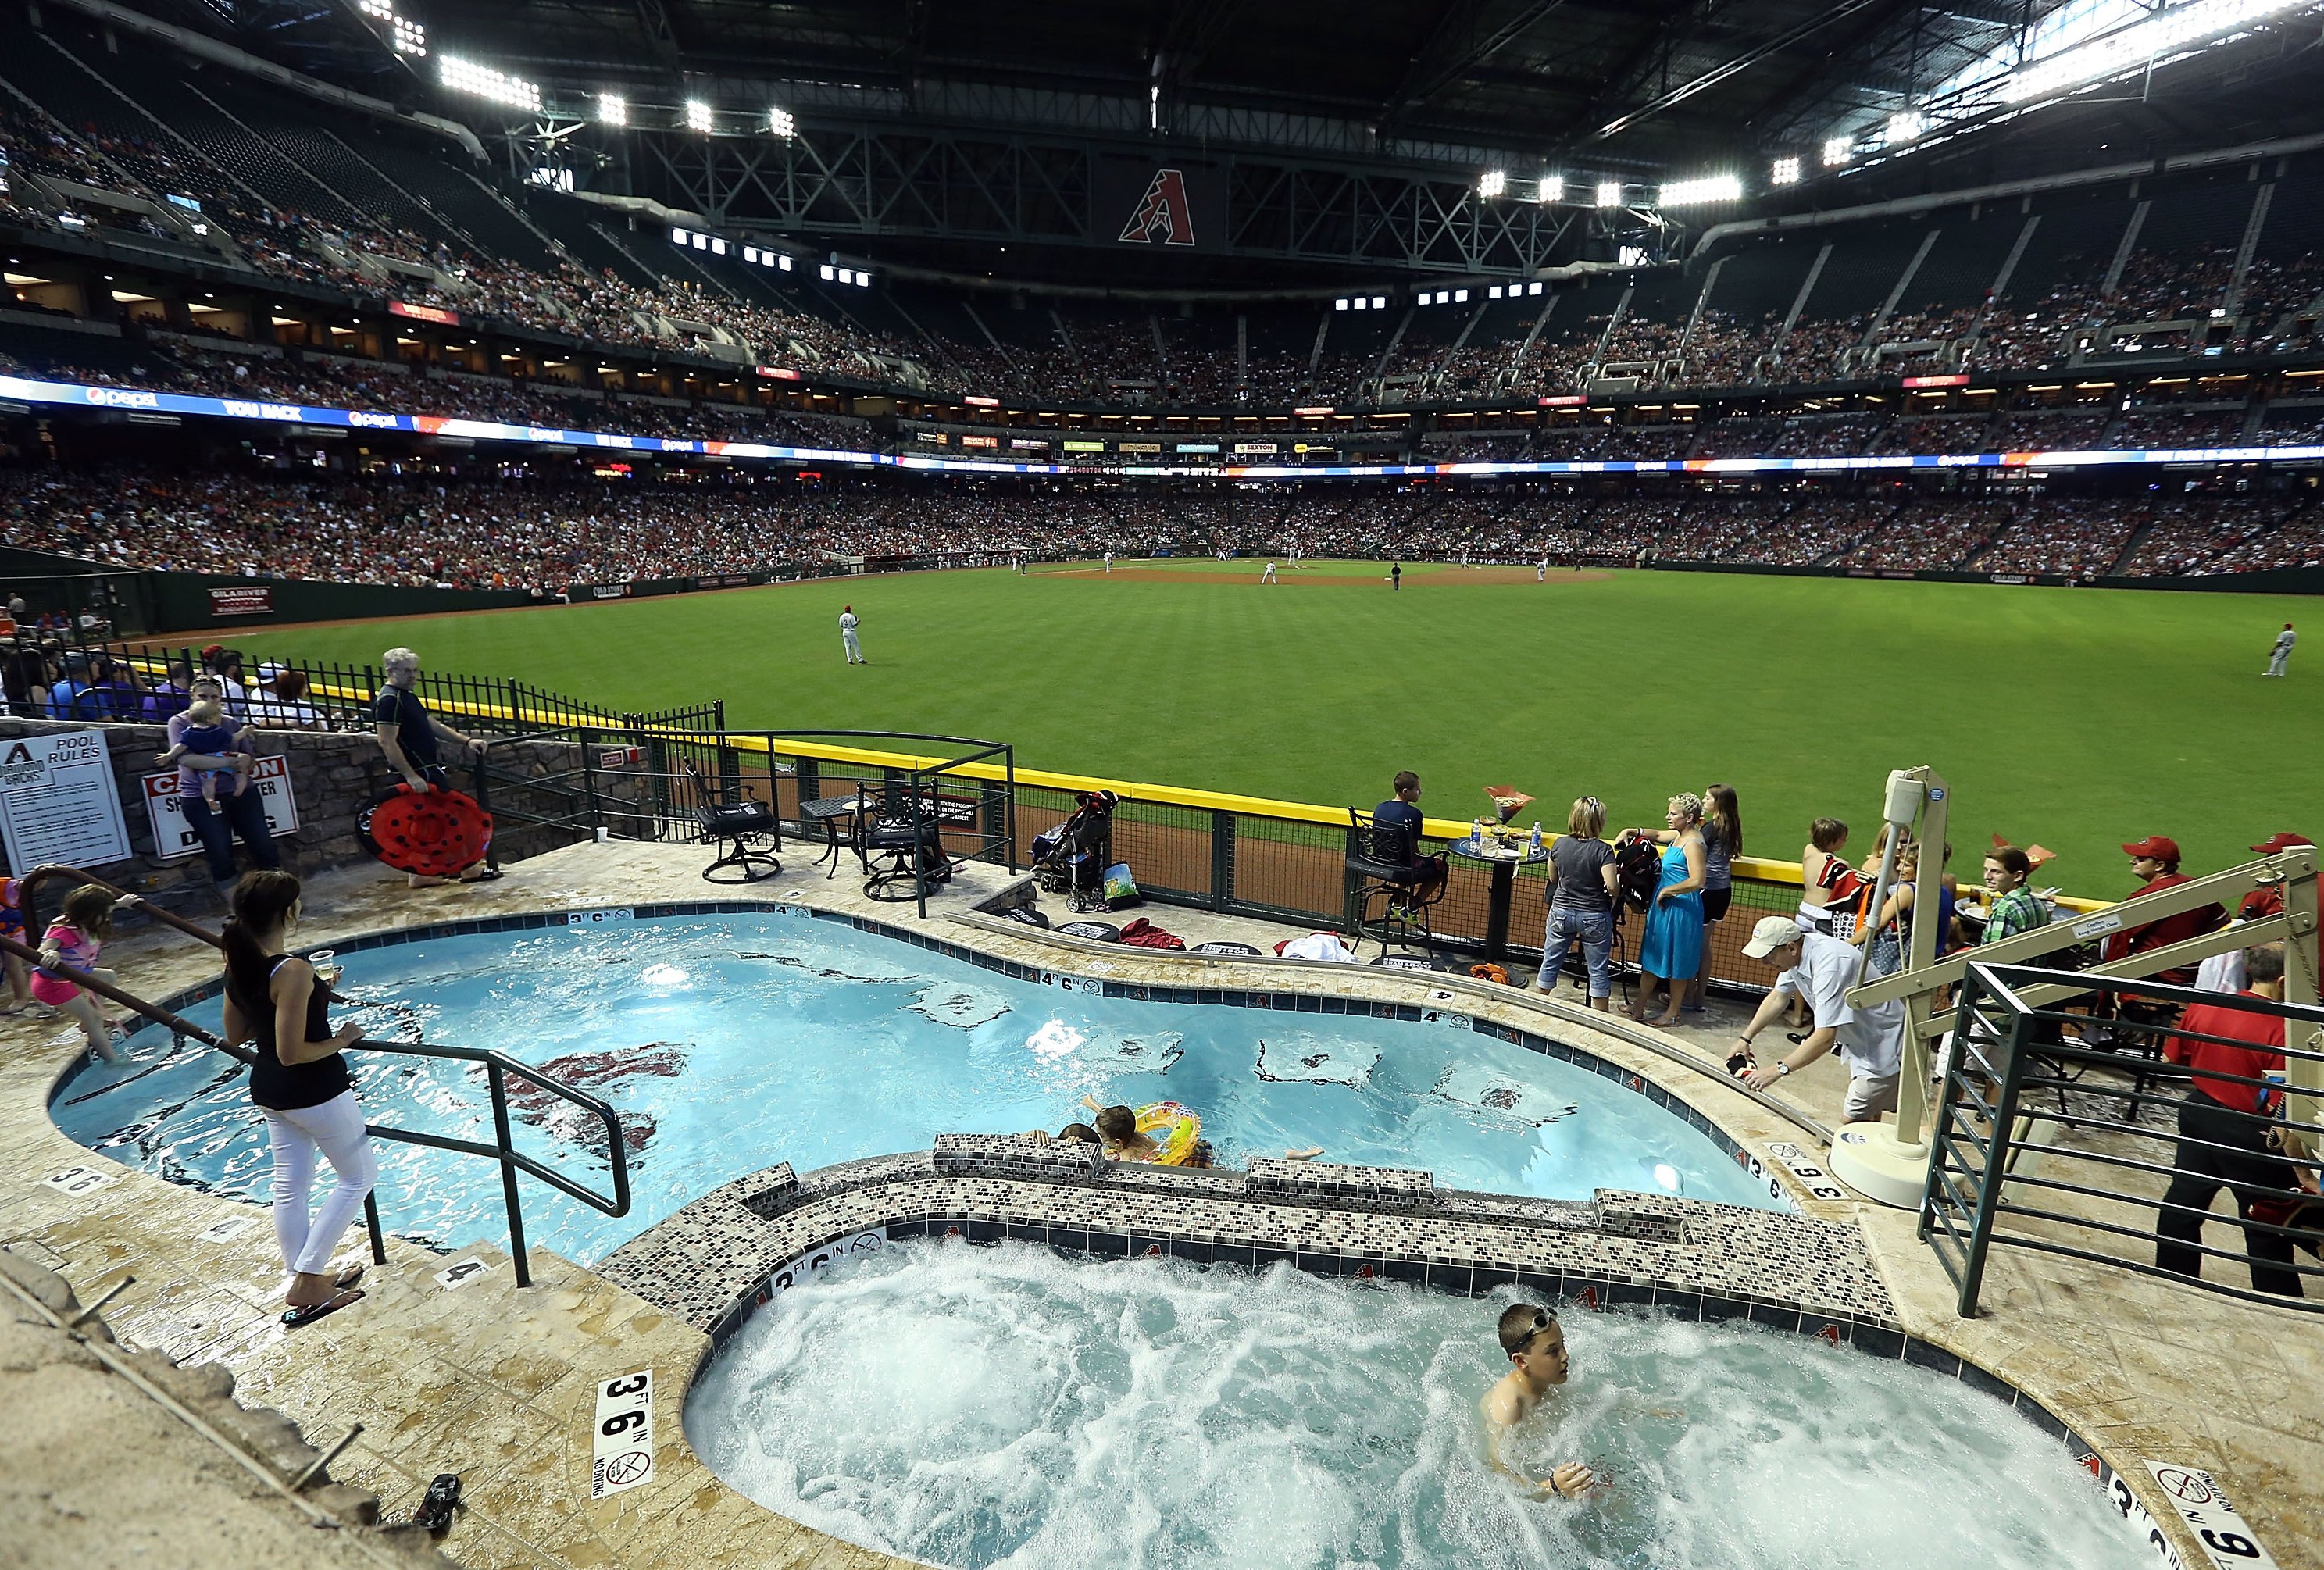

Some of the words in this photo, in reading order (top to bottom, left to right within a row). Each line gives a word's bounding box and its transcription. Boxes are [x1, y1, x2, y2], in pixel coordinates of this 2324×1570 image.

[105, 390, 159, 408] pepsi
[222, 400, 259, 419] YOU
[262, 402, 302, 422] BACK
[362, 414, 398, 429] pepsi
[56, 736, 98, 751] POOL
[48, 747, 100, 764] RULES
[257, 780, 277, 796] TER
[776, 905, 787, 914] 4
[570, 914, 582, 923] 3
[1042, 972, 1053, 986] 4
[1062, 977, 1072, 990] 6
[1423, 1011, 1438, 1022] 4
[52, 1168, 80, 1183] 3
[1751, 1158, 1762, 1179] 3
[1770, 1179, 1780, 1199] 6
[1813, 1187, 1841, 1198] 3
[794, 1259, 806, 1275] FT
[832, 1244, 844, 1258] IN
[447, 1262, 481, 1283] 4
[606, 1375, 648, 1398] 3
[634, 1391, 649, 1404] FT
[602, 1410, 646, 1436] 6
[633, 1429, 648, 1443] IN
[594, 1458, 605, 1470] NO
[593, 1470, 605, 1497] DIVING
[2197, 1472, 2223, 1499] DIVING
[2114, 1479, 2133, 1518] 3
[2135, 1500, 2150, 1522] FT
[2218, 1500, 2237, 1513] NO
[2182, 1508, 2207, 1525] IN
[2169, 1554, 2181, 1570] IN
